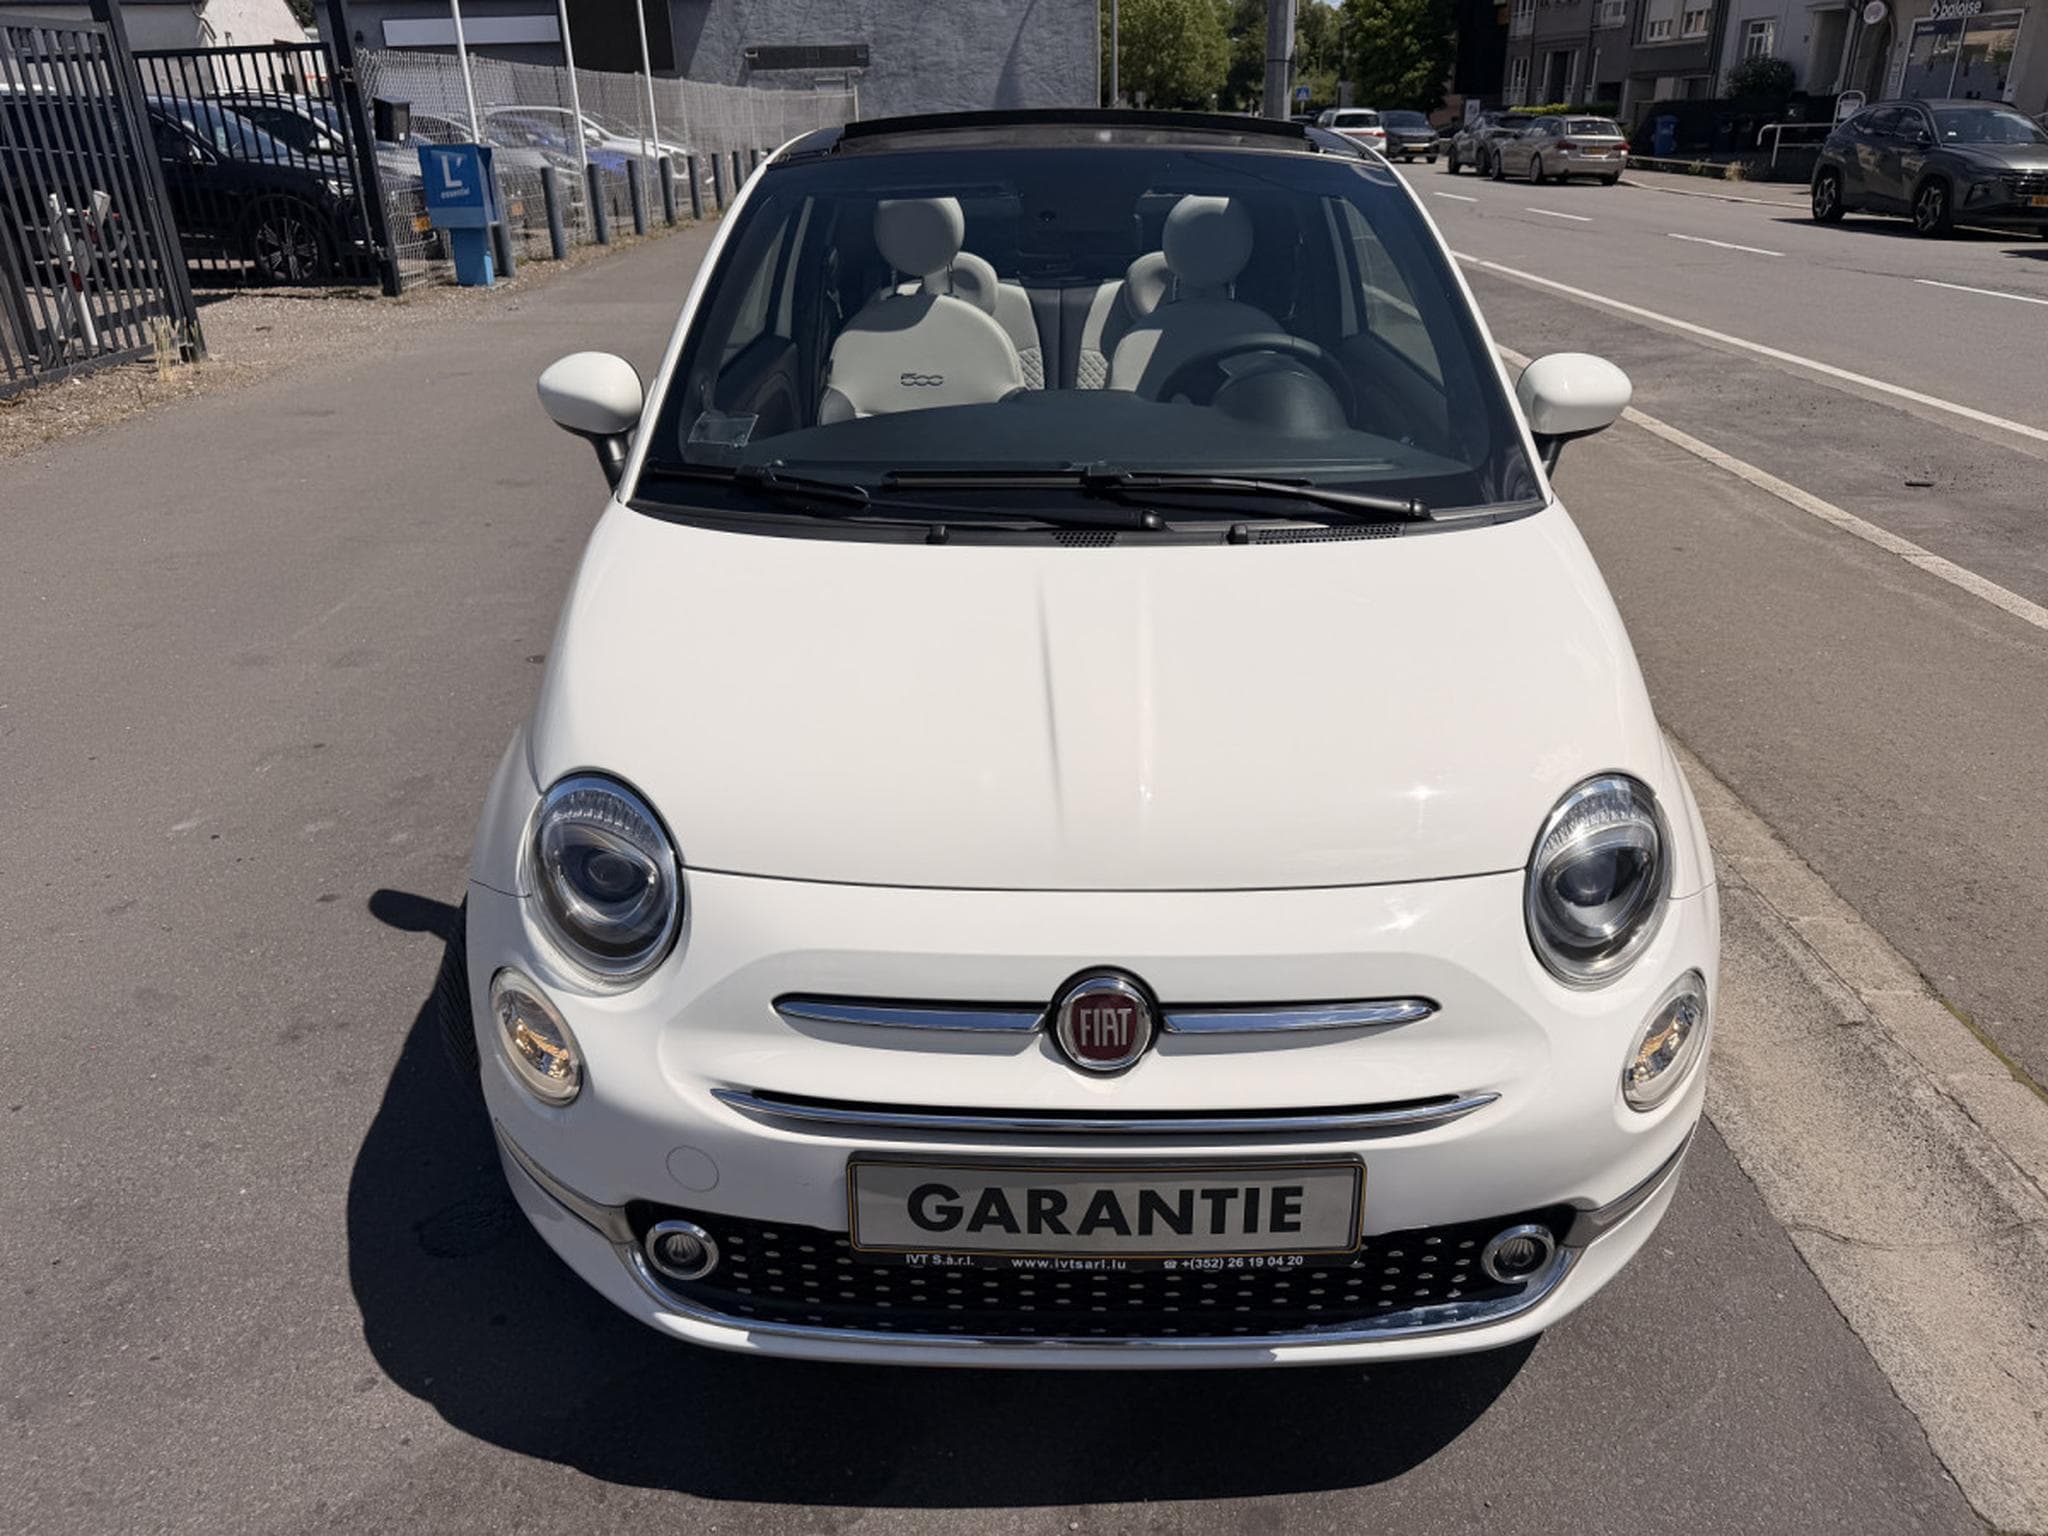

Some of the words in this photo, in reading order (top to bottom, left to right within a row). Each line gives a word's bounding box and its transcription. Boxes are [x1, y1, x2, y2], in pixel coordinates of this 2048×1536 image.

[900, 373, 943, 387] 500
[1080, 1008, 1132, 1047] FIAT
[907, 1183, 1305, 1237] GARANTIE
[905, 1254, 928, 1265] IVT
[1011, 1258, 1127, 1270] www.ivtsarl.lu
[1227, 1257, 1244, 1268] 26
[1249, 1256, 1264, 1268] 19
[1267, 1256, 1284, 1267] 04
[1287, 1255, 1304, 1266] 20
